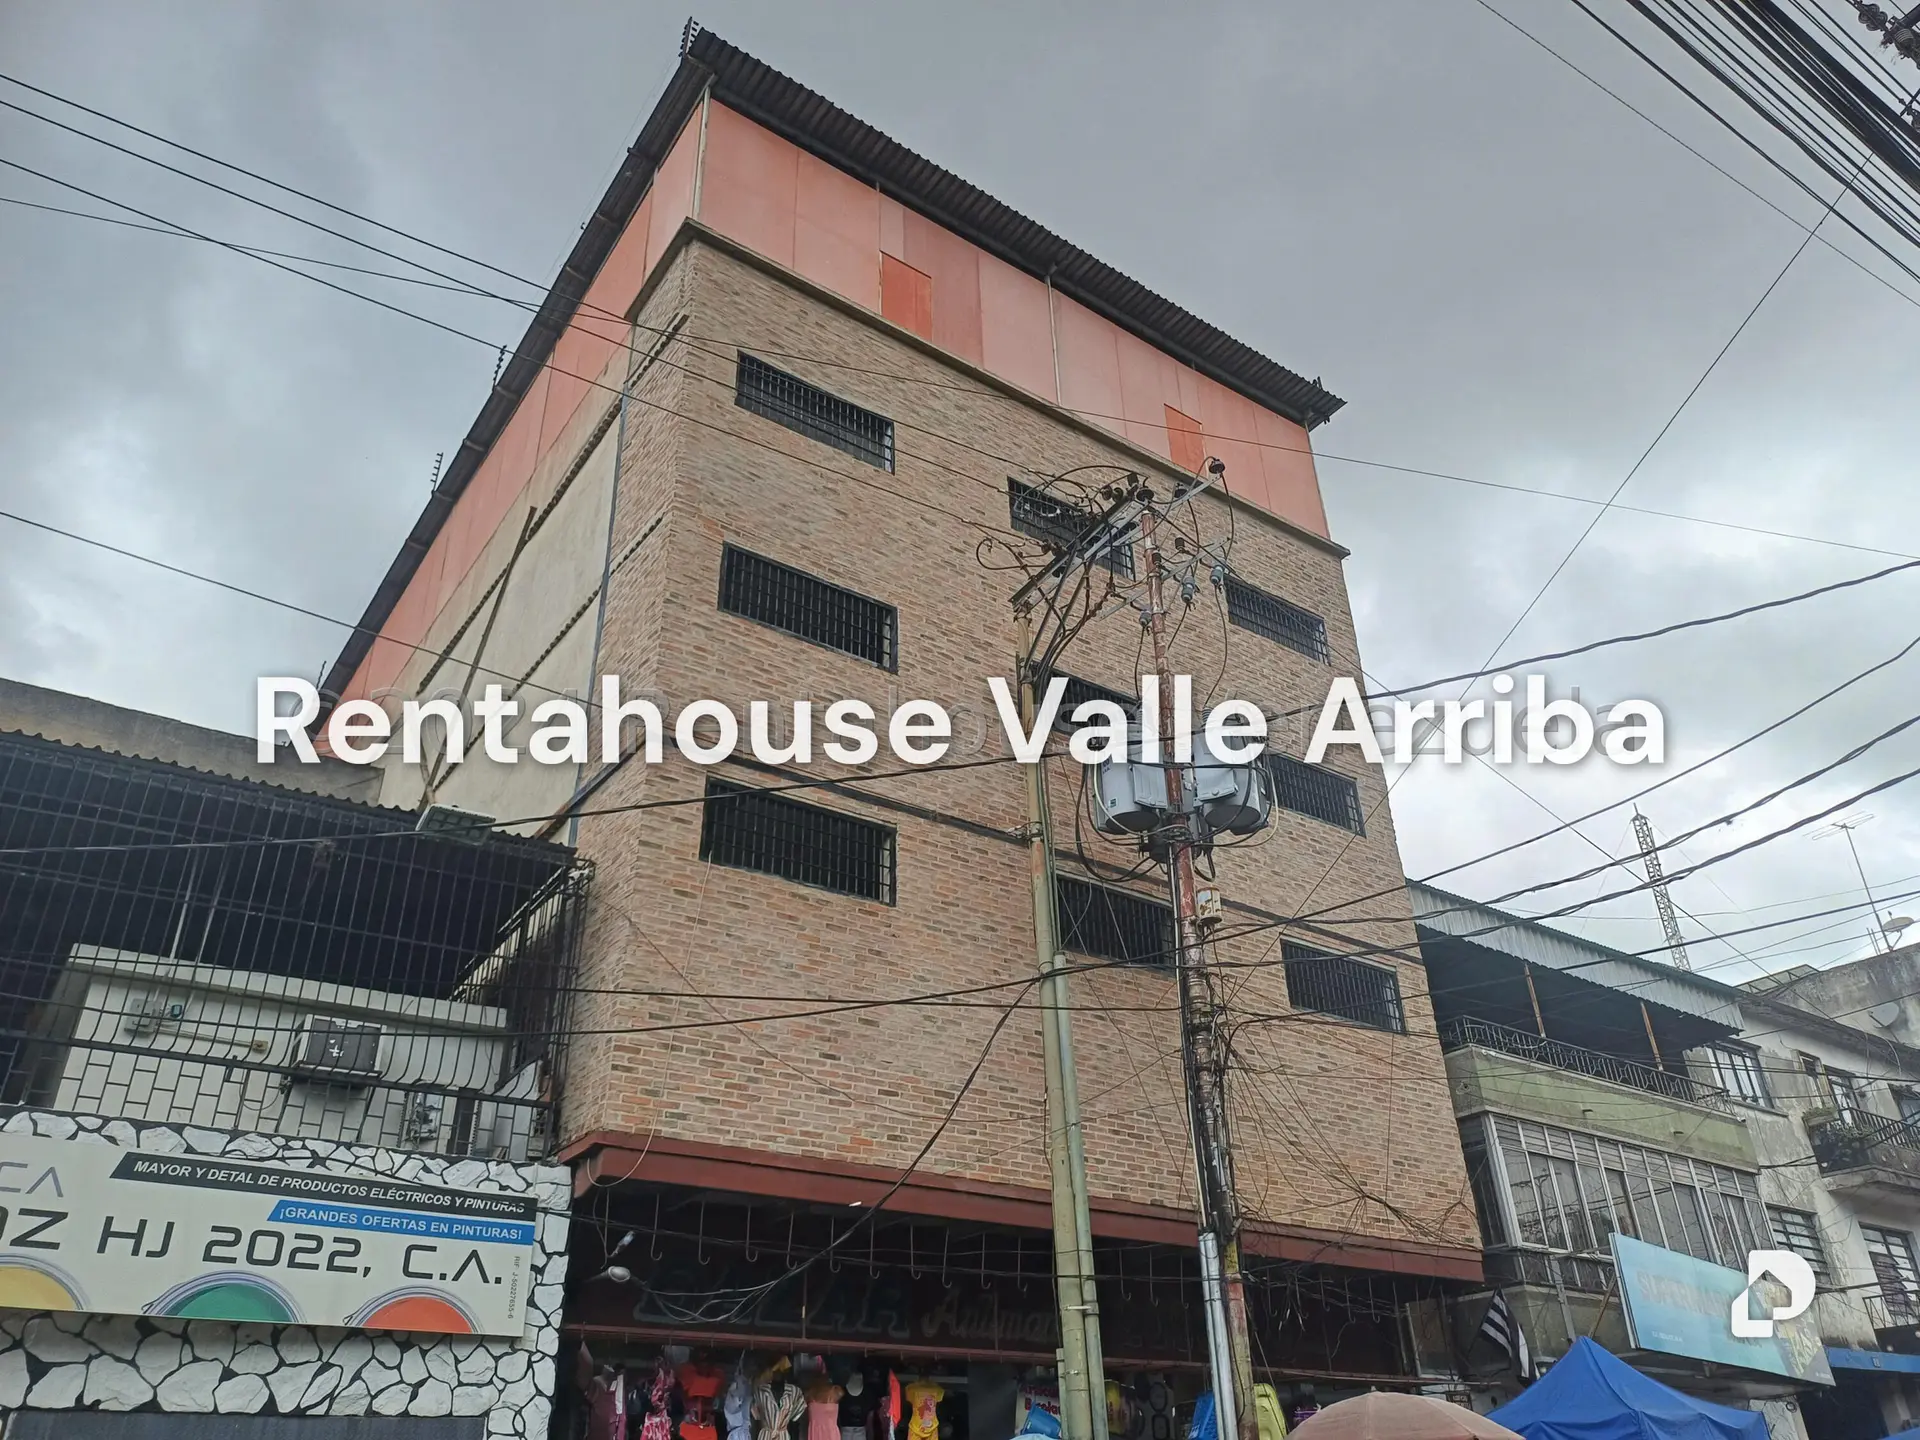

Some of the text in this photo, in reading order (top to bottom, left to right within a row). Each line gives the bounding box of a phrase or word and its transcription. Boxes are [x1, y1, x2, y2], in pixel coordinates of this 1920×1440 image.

[133, 1160, 526, 1214] MAYOR Y DETAL DE PRODUCTOS ELÉCTRICOS Y PINTURAS
[97, 1216, 176, 1259] HJ
[202, 1225, 372, 1278] 2022,
[403, 1244, 502, 1285] C.A.
[279, 1206, 523, 1241] ¡GRANDES OFERTAS EN PINTURAS!
